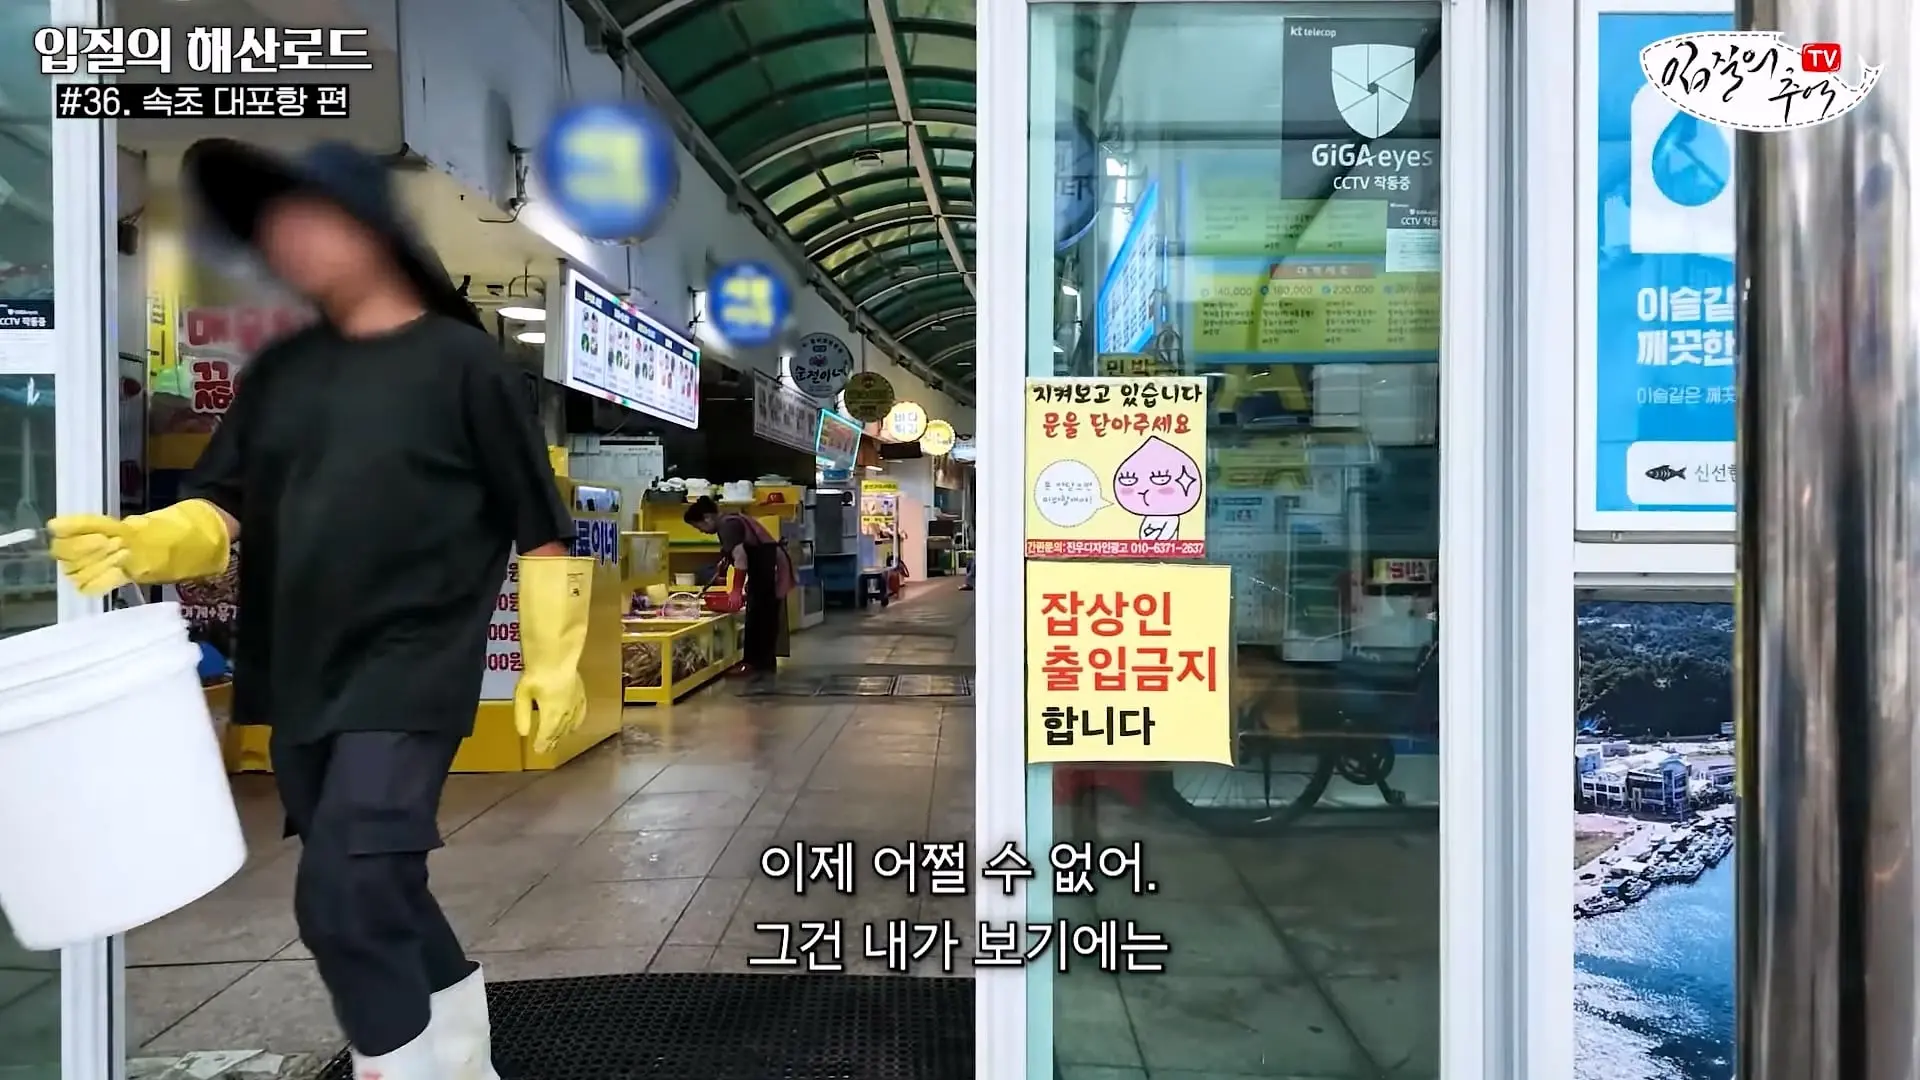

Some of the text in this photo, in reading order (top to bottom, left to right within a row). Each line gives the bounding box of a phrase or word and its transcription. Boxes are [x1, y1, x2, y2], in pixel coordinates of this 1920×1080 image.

[1291, 26, 1336, 38] kt telecop
[1311, 143, 1434, 171] GiGA eyes
[1333, 175, 1411, 190] CCTV 작동중
[1401, 217, 1421, 225] CCTV
[1033, 382, 1203, 408] 지켜보고 있습니다
[1636, 387, 1703, 405] 이슬같은
[1042, 411, 1192, 439] 문을 닫아주세요
[1130, 541, 1204, 554] 010-6371-2637
[1041, 591, 1172, 637] 잡상인
[1041, 645, 1217, 692] 출입금지
[1041, 706, 1156, 746] 합니다
